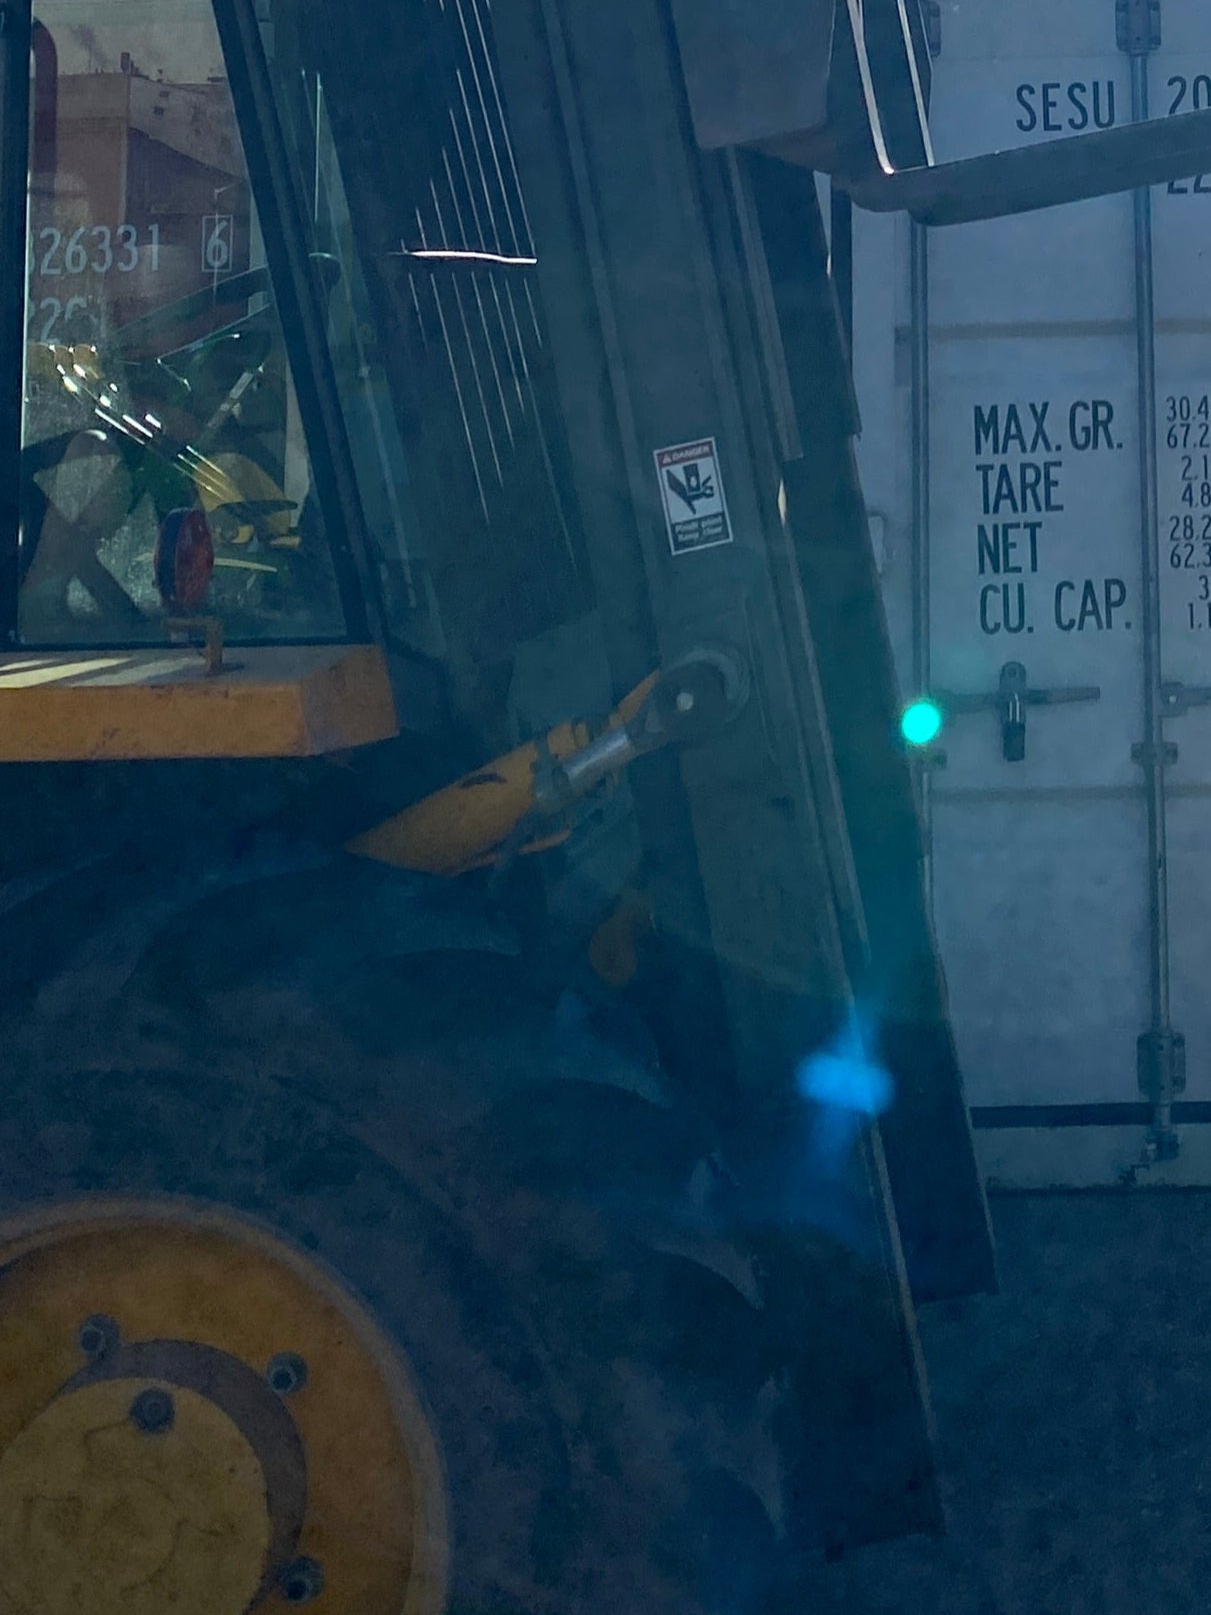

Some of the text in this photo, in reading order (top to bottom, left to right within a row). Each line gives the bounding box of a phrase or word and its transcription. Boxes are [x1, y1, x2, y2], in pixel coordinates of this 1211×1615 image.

[1015, 80, 1116, 133] SESU
[206, 218, 229, 269] 6
[975, 460, 1065, 516] TARE
[976, 521, 1043, 575] NET
[979, 578, 1132, 635] CU. CAP.
